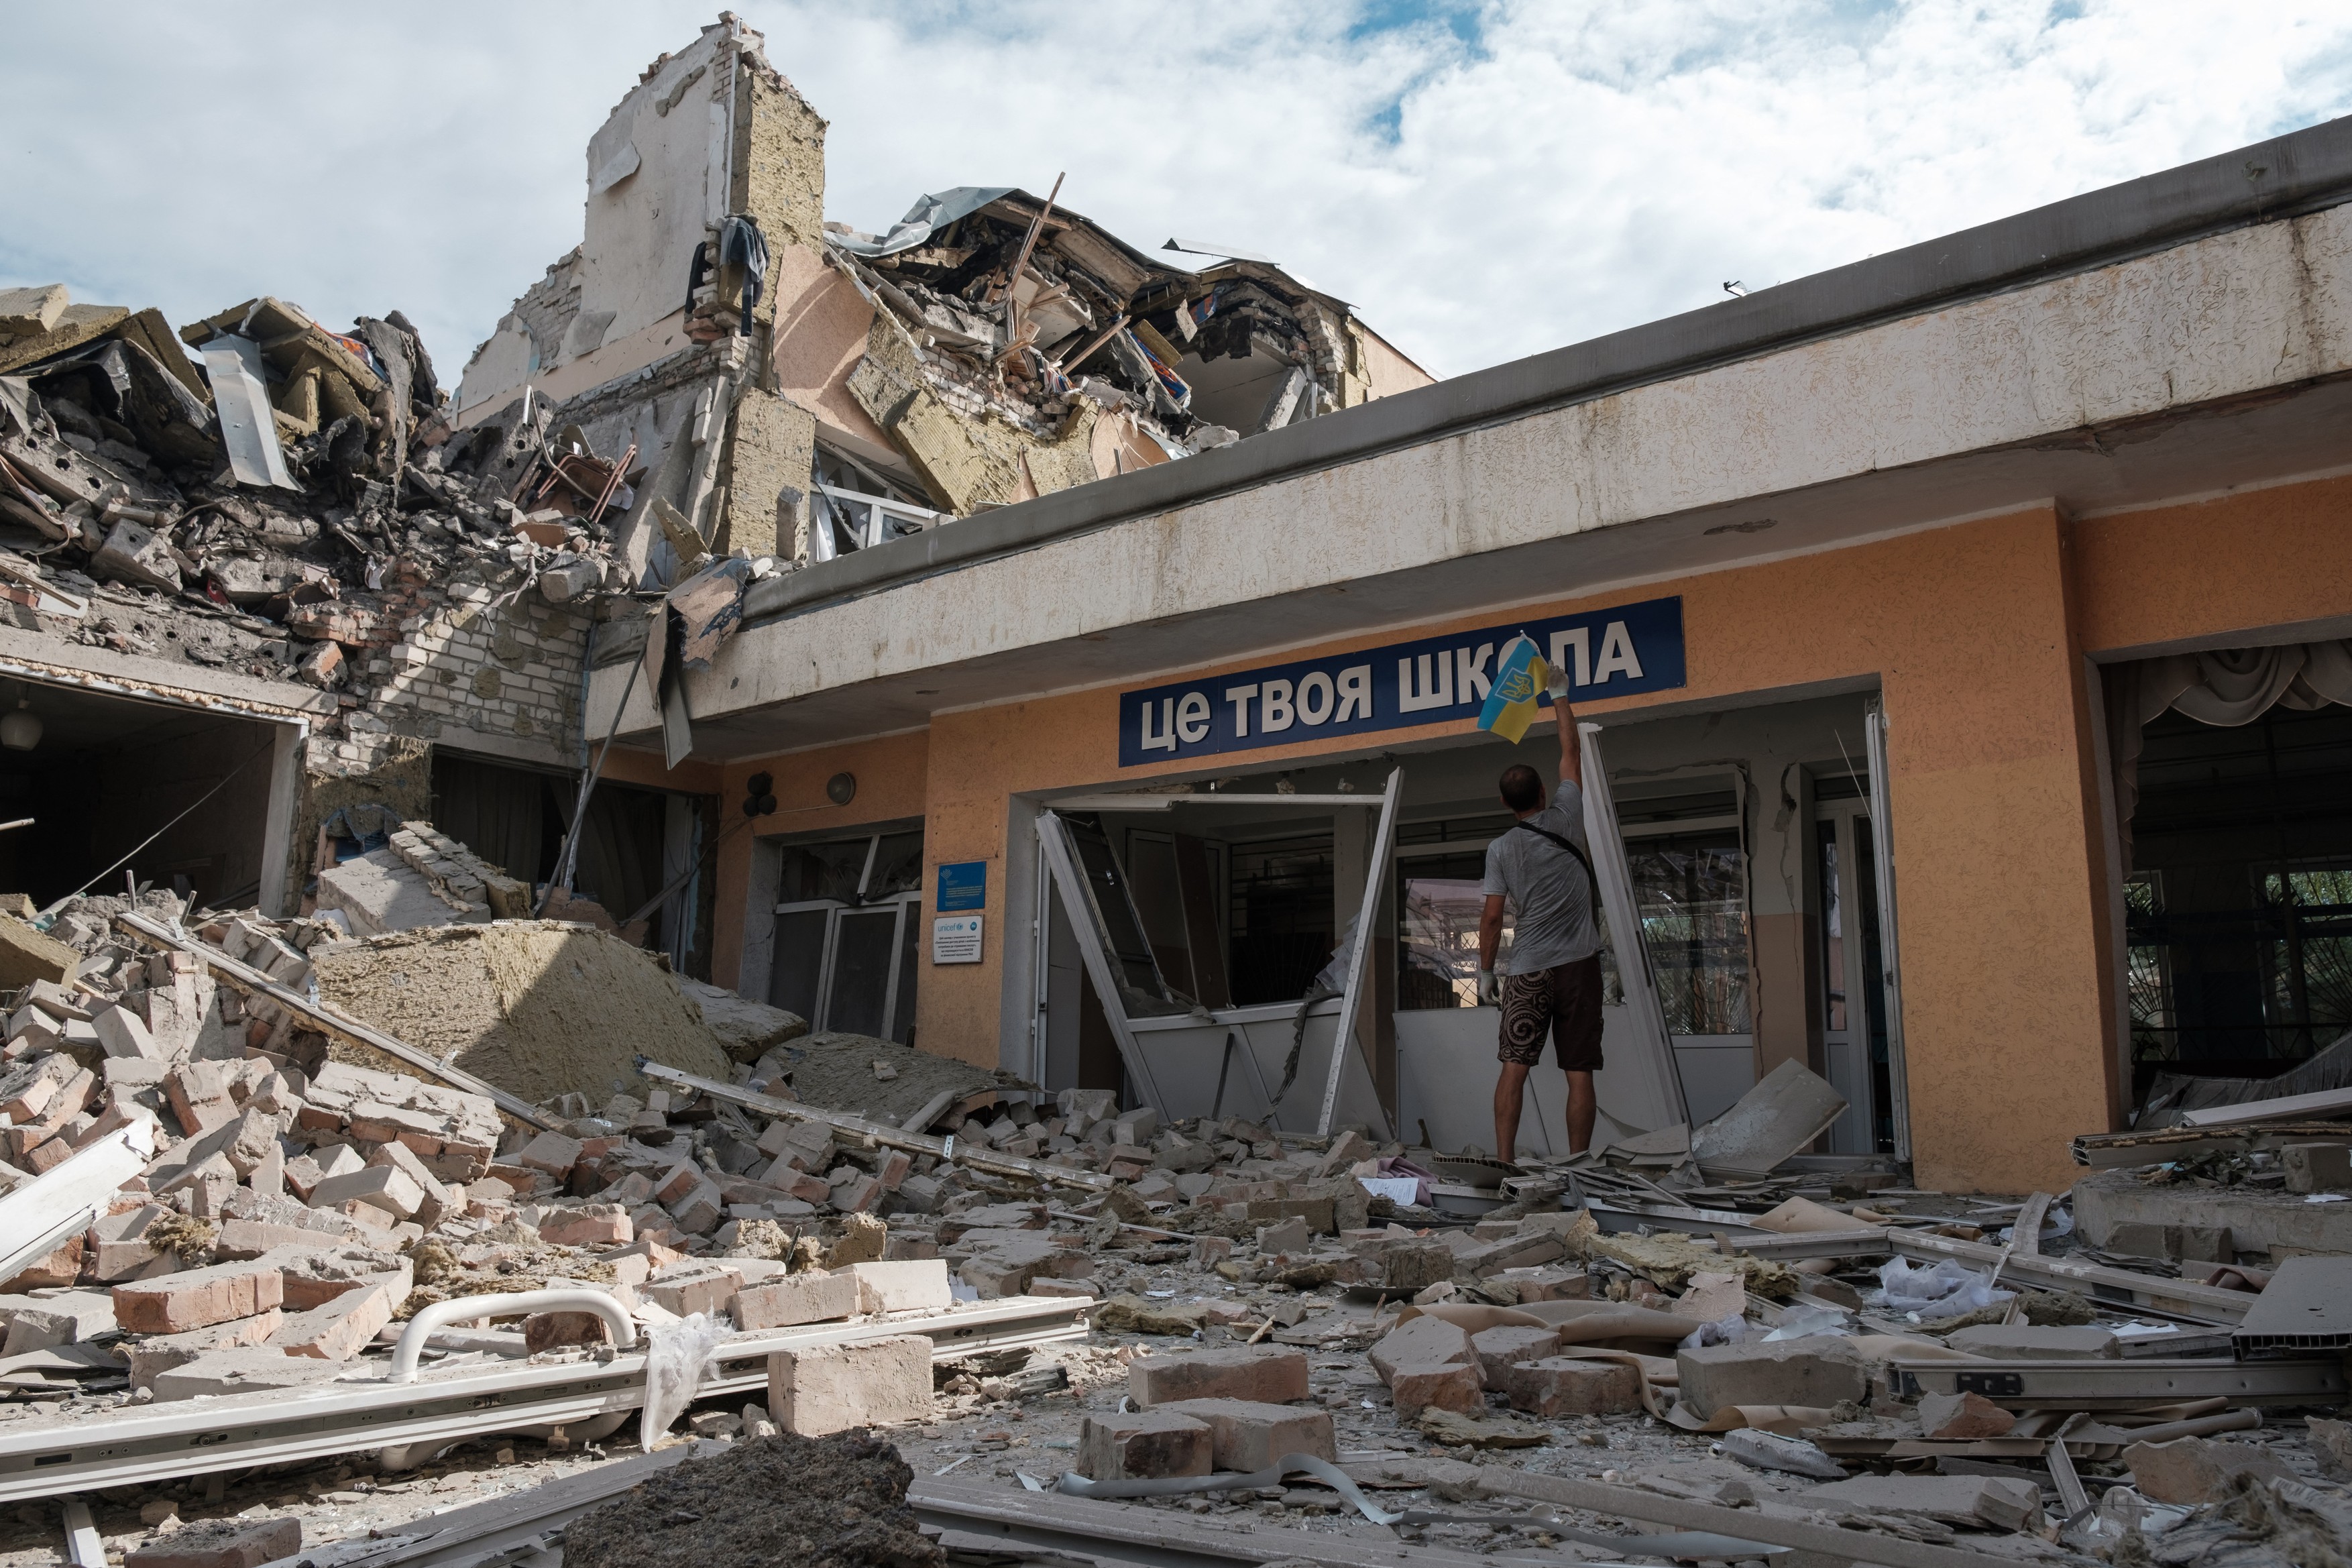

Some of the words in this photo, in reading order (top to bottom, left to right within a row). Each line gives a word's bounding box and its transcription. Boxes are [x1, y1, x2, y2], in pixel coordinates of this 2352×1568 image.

[1226, 664, 1372, 738] ТВОЯ
[1398, 620, 1644, 714] ШКЛА
[938, 923, 956, 932] unicef
